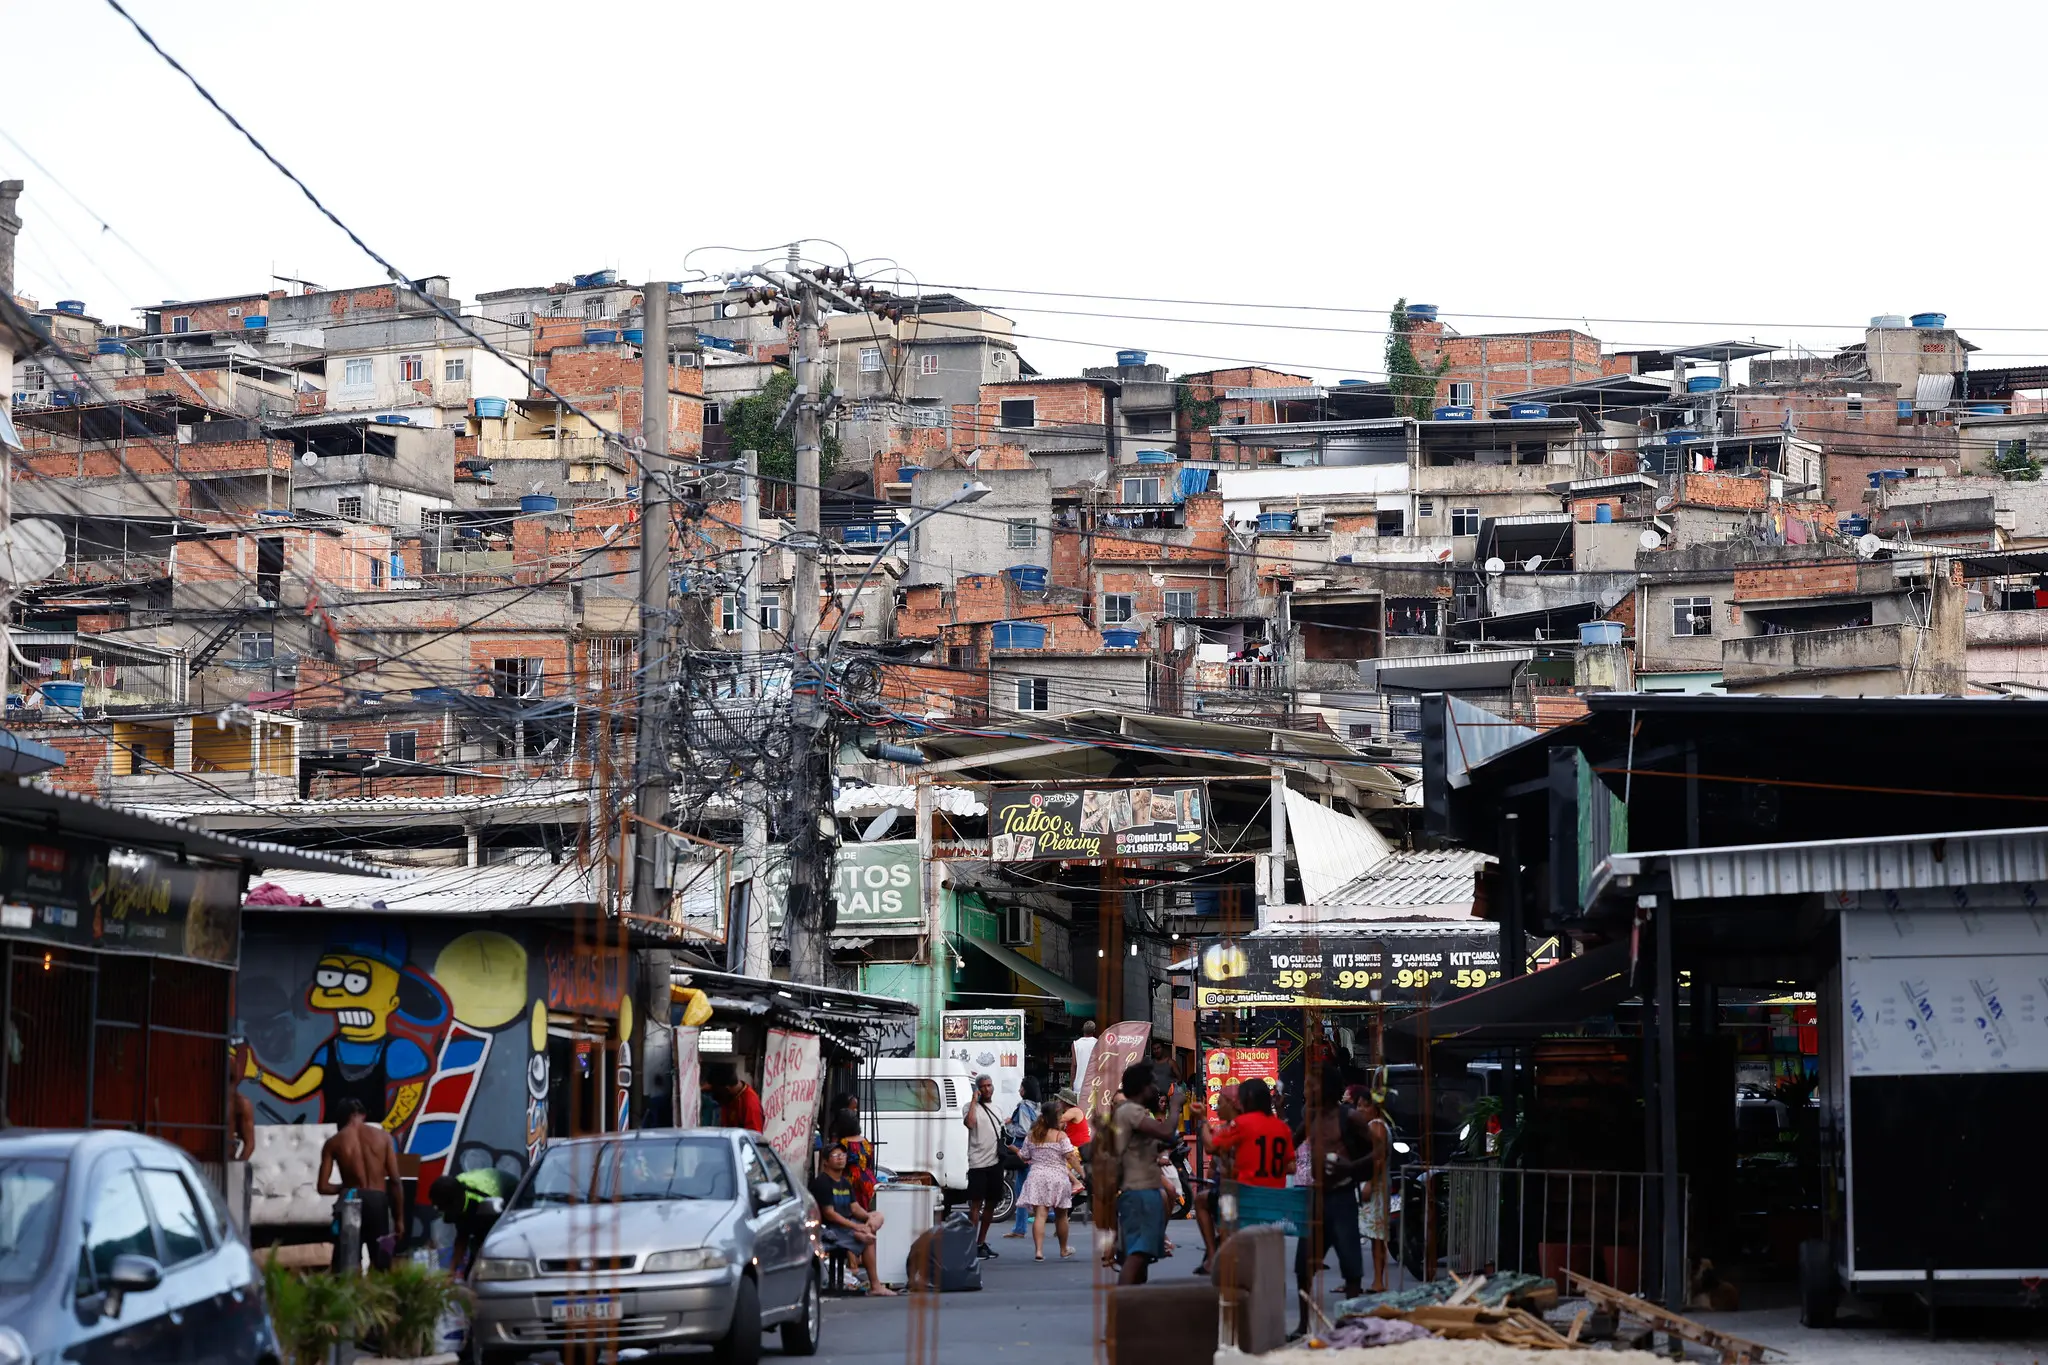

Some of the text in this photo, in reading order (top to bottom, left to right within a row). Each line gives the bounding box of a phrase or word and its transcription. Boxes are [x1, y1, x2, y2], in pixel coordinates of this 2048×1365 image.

[1000, 803, 1074, 836] Tattoo &
[1038, 831, 1100, 856] Piercing
[1126, 832, 1172, 843] @point.tp1
[1126, 843, 1189, 853] 21.96972-5843
[844, 851, 857, 860] DE
[1270, 955, 1289, 968] 10
[1333, 954, 1346, 968] KIT
[1348, 954, 1354, 967] 3
[1392, 953, 1442, 967] 3 CAMISAS
[1450, 952, 1471, 966] KIT
[1471, 952, 1495, 960] CAMISA
[1235, 1051, 1270, 1061] Salgados
[1255, 1135, 1287, 1177] 18
